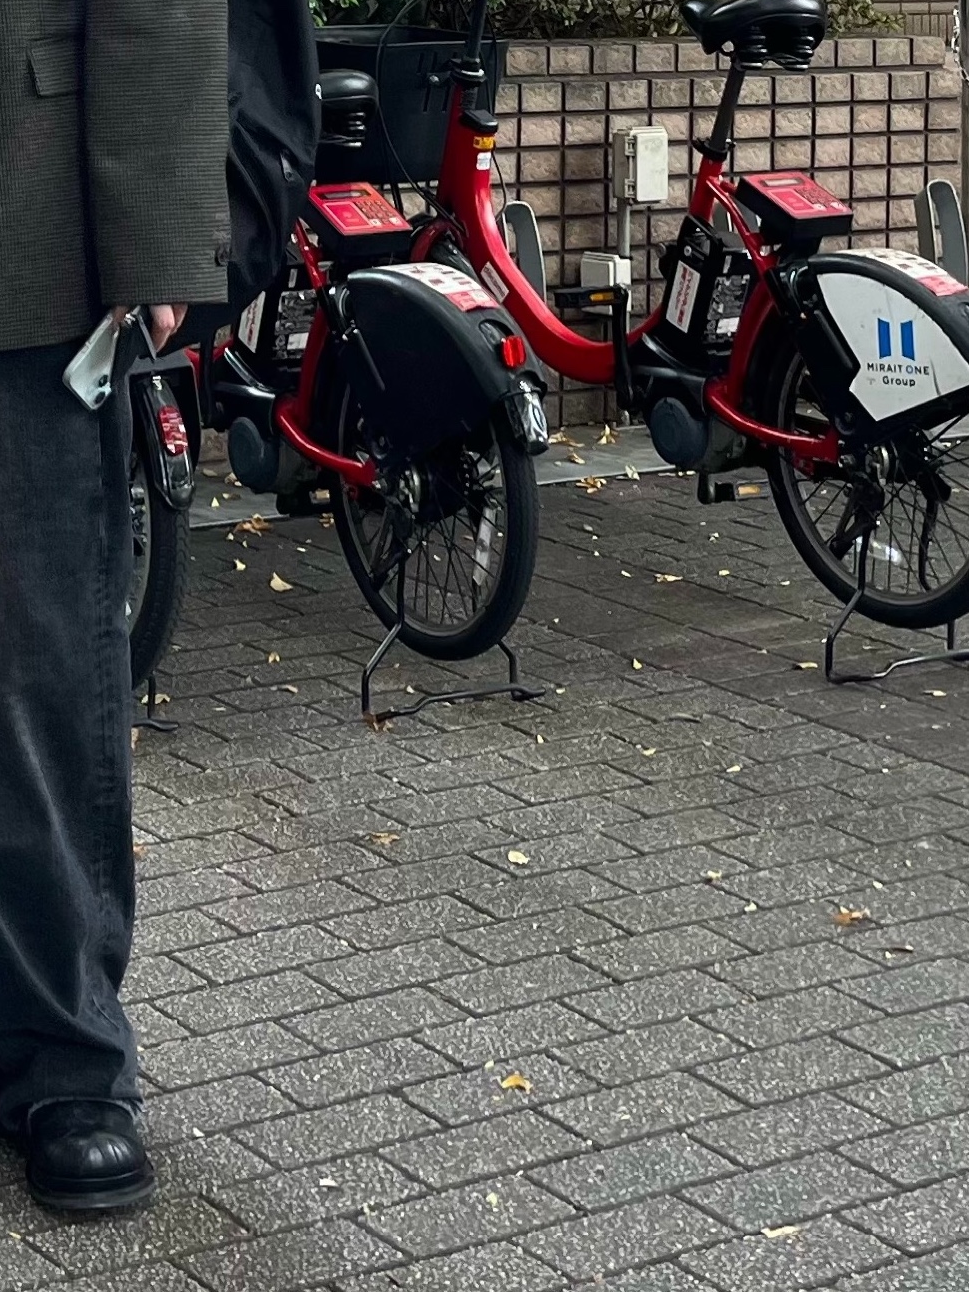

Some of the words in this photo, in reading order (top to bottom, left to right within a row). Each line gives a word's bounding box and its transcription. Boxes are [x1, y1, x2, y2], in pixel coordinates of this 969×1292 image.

[867, 362, 903, 374] MIRAIT
[906, 365, 930, 375] ONE
[882, 375, 916, 387] Group
